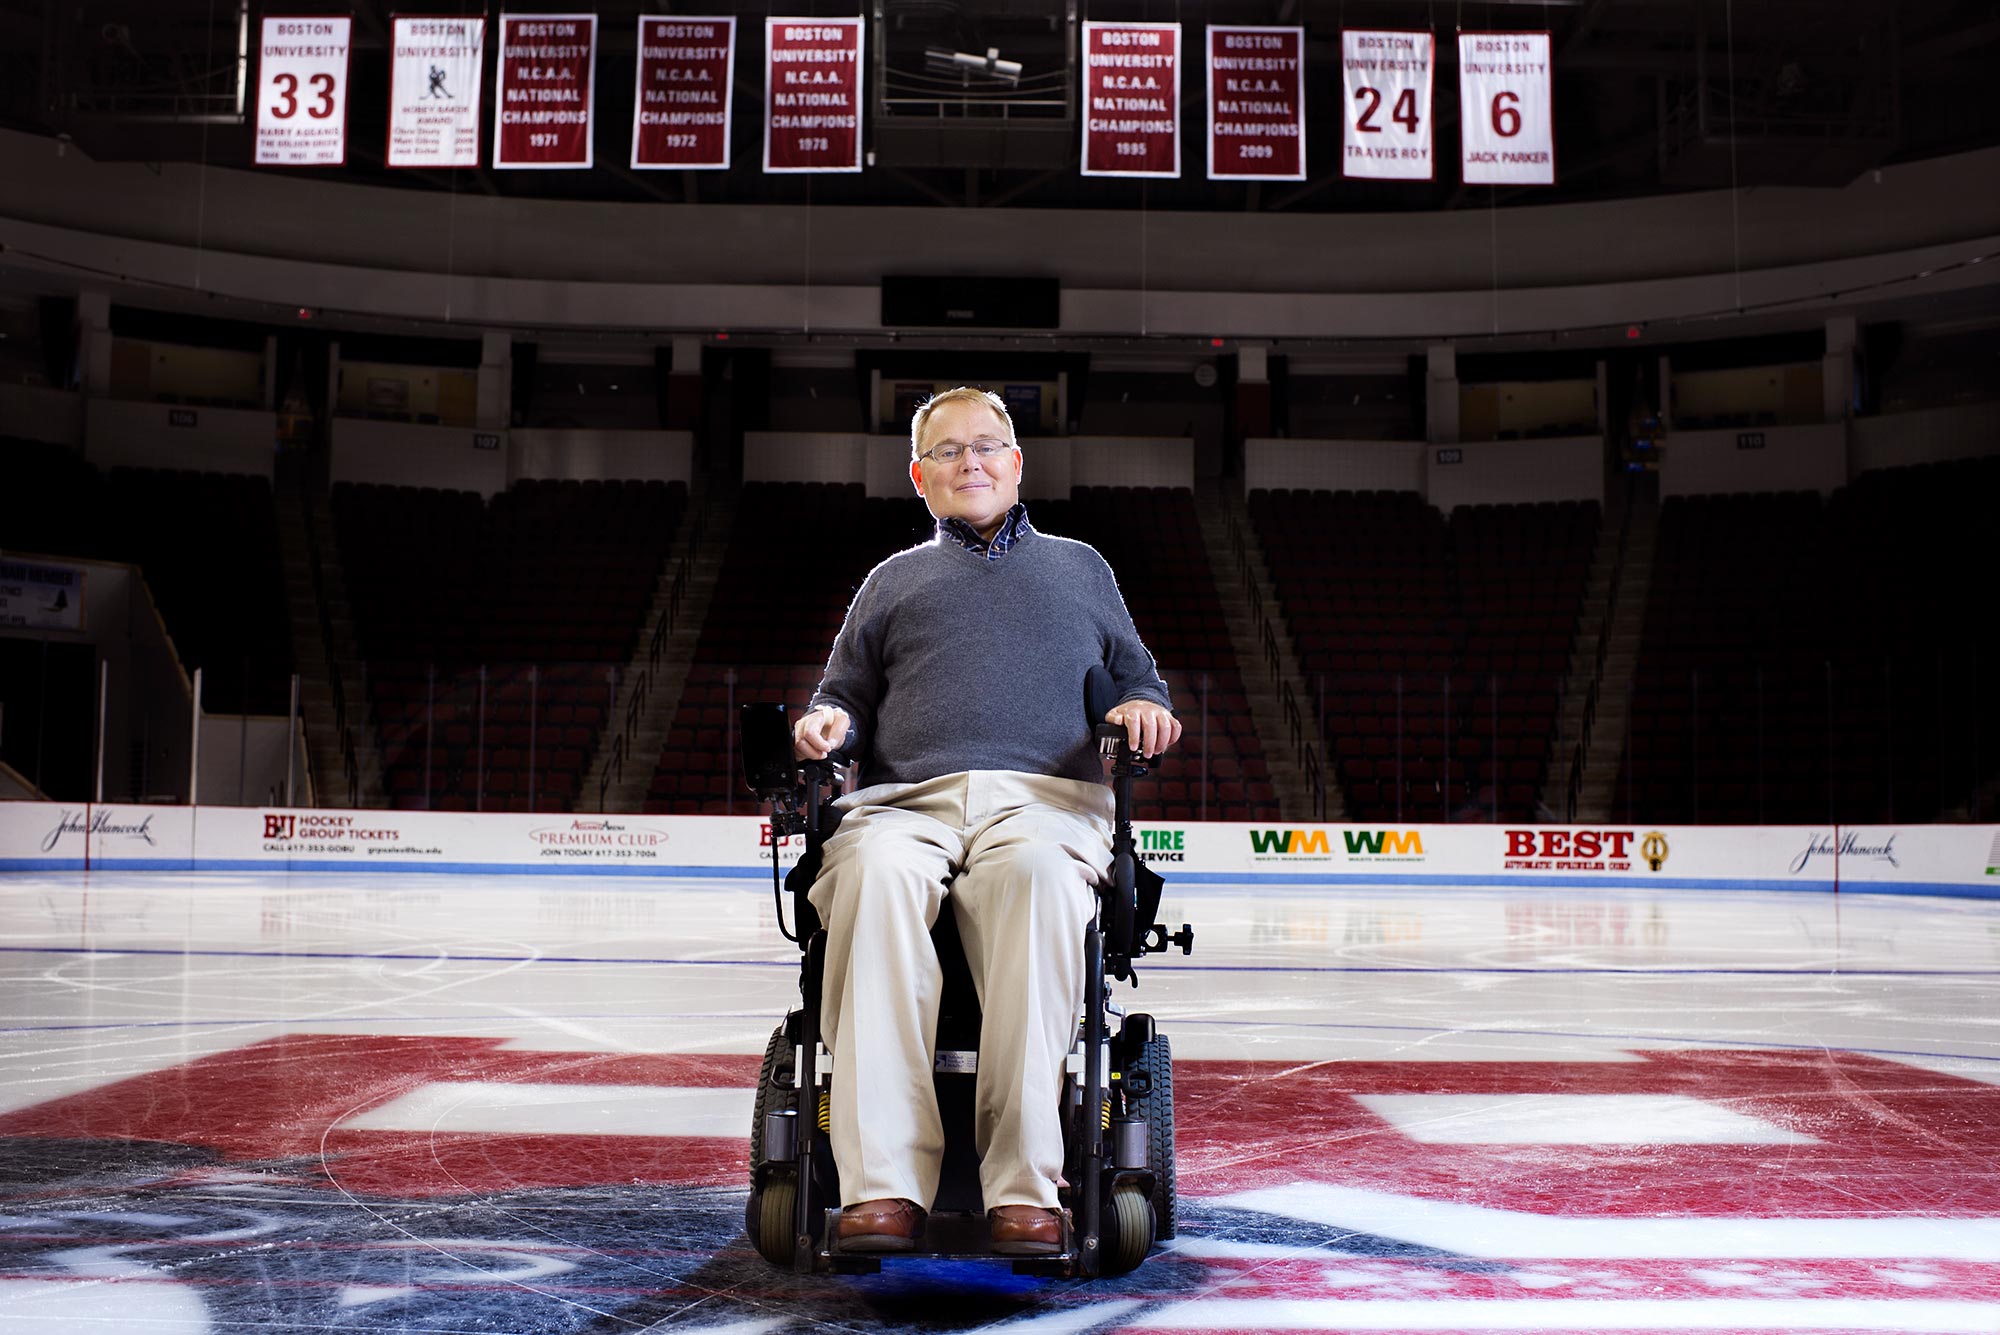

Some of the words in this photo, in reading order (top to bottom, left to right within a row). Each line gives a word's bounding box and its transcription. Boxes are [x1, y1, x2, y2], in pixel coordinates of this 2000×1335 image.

[278, 24, 333, 36] BOSTON
[411, 25, 466, 36] BOSTON
[519, 24, 576, 37] BOSTON
[657, 25, 714, 38] BOSTON
[784, 28, 843, 41] BOSTON
[1102, 32, 1160, 46] BOSTON
[1225, 35, 1282, 49] BOSTON
[1358, 37, 1414, 50] BOSTON
[265, 46, 346, 58] UNIVERSITY
[397, 46, 479, 58] UNIVERSITY
[505, 45, 589, 58] UNIVERSITY
[1475, 41, 1530, 52] BOSTON
[643, 47, 727, 60] UNIVERSITY
[772, 49, 857, 62] UNIVERSITY
[1090, 53, 1174, 68] UNIVERSITY
[1213, 57, 1298, 71] UNIVERSITY
[1346, 59, 1428, 72] UNIVERSITY
[518, 67, 575, 80] N.C.A.A.
[656, 69, 712, 81] N.C.A.A.
[1464, 63, 1545, 74] UNIVERSITY
[785, 71, 843, 84] N.C.A.A.
[1103, 75, 1161, 90] N.C.A.A.
[1226, 79, 1284, 92] N.C.A.A.
[271, 73, 336, 119] 33
[507, 89, 580, 102] NATIONAL
[646, 90, 718, 103] NATIONAL
[775, 93, 849, 106] NATIONAL
[1094, 97, 1167, 111] NATIONAL
[1218, 101, 1291, 114] NATIONAL
[1355, 87, 1419, 134] 24
[502, 110, 587, 124] CHAMPIONS
[641, 111, 724, 125] CHAMPIONS
[1491, 91, 1522, 137] 6
[771, 115, 856, 128] CHAMPIONS
[1090, 119, 1174, 133] CHAMPIONS
[1214, 122, 1298, 136] CHAMPIONS
[530, 134, 558, 147] 1971
[667, 134, 697, 147] 1972
[798, 138, 829, 150] 1978
[1116, 142, 1147, 155] 1995
[1239, 144, 1273, 158] 2009
[1346, 146, 1398, 159] TRAVIS
[1401, 147, 1428, 159] ROY
[1466, 152, 1498, 164] JACK
[1501, 151, 1550, 164] PARKER
[476, 436, 497, 447] 107
[264, 815, 296, 839] BU
[300, 816, 354, 826] HOCKEY
[299, 828, 344, 839] GROUP
[349, 830, 399, 840] TICKETS
[539, 832, 614, 846] PREMIUM
[618, 833, 657, 846] CLUB
[1140, 830, 1185, 850] TIRE
[263, 843, 284, 852] CALL
[1250, 830, 1331, 853] WM
[1343, 831, 1424, 854] WM
[1504, 830, 1634, 858] BEST
[540, 848, 562, 857] JOIN
[563, 849, 593, 857] TODAY
